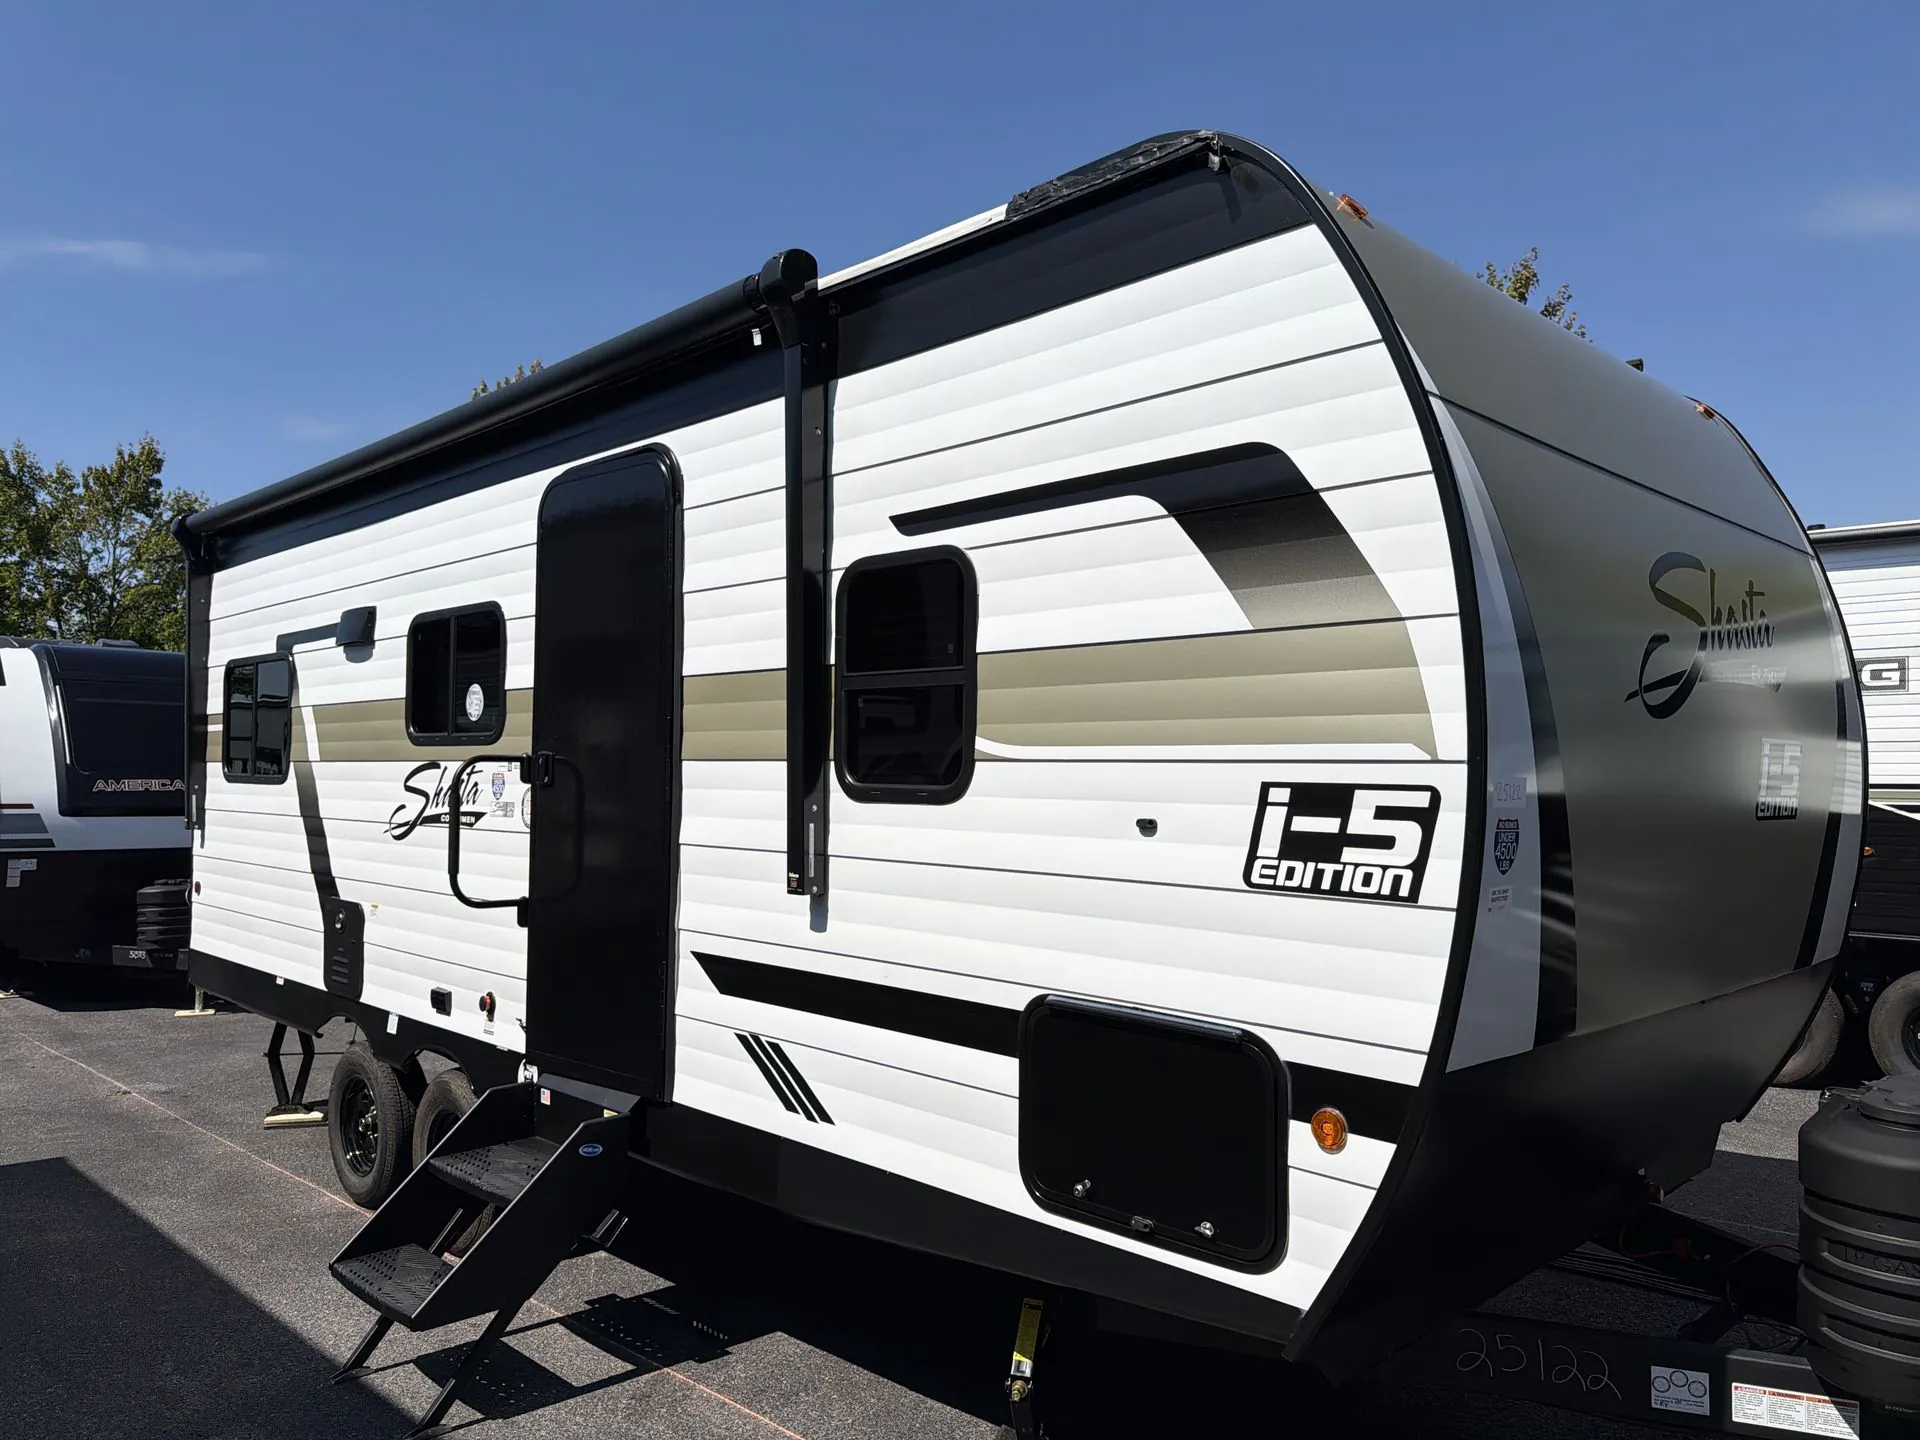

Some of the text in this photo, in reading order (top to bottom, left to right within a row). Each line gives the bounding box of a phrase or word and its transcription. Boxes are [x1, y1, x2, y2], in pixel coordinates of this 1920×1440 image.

[1638, 551, 1775, 719] Shasta
[1861, 662, 1901, 687] G
[92, 779, 186, 791] AMERICA
[441, 814, 476, 824] COMEN
[1256, 786, 1431, 867] i-5
[1498, 832, 1516, 842] UNDER
[1495, 843, 1517, 860] 4500
[1500, 860, 1510, 870] LBS
[1250, 858, 1414, 898] EDITION
[1456, 1327, 1623, 1401] 25122
